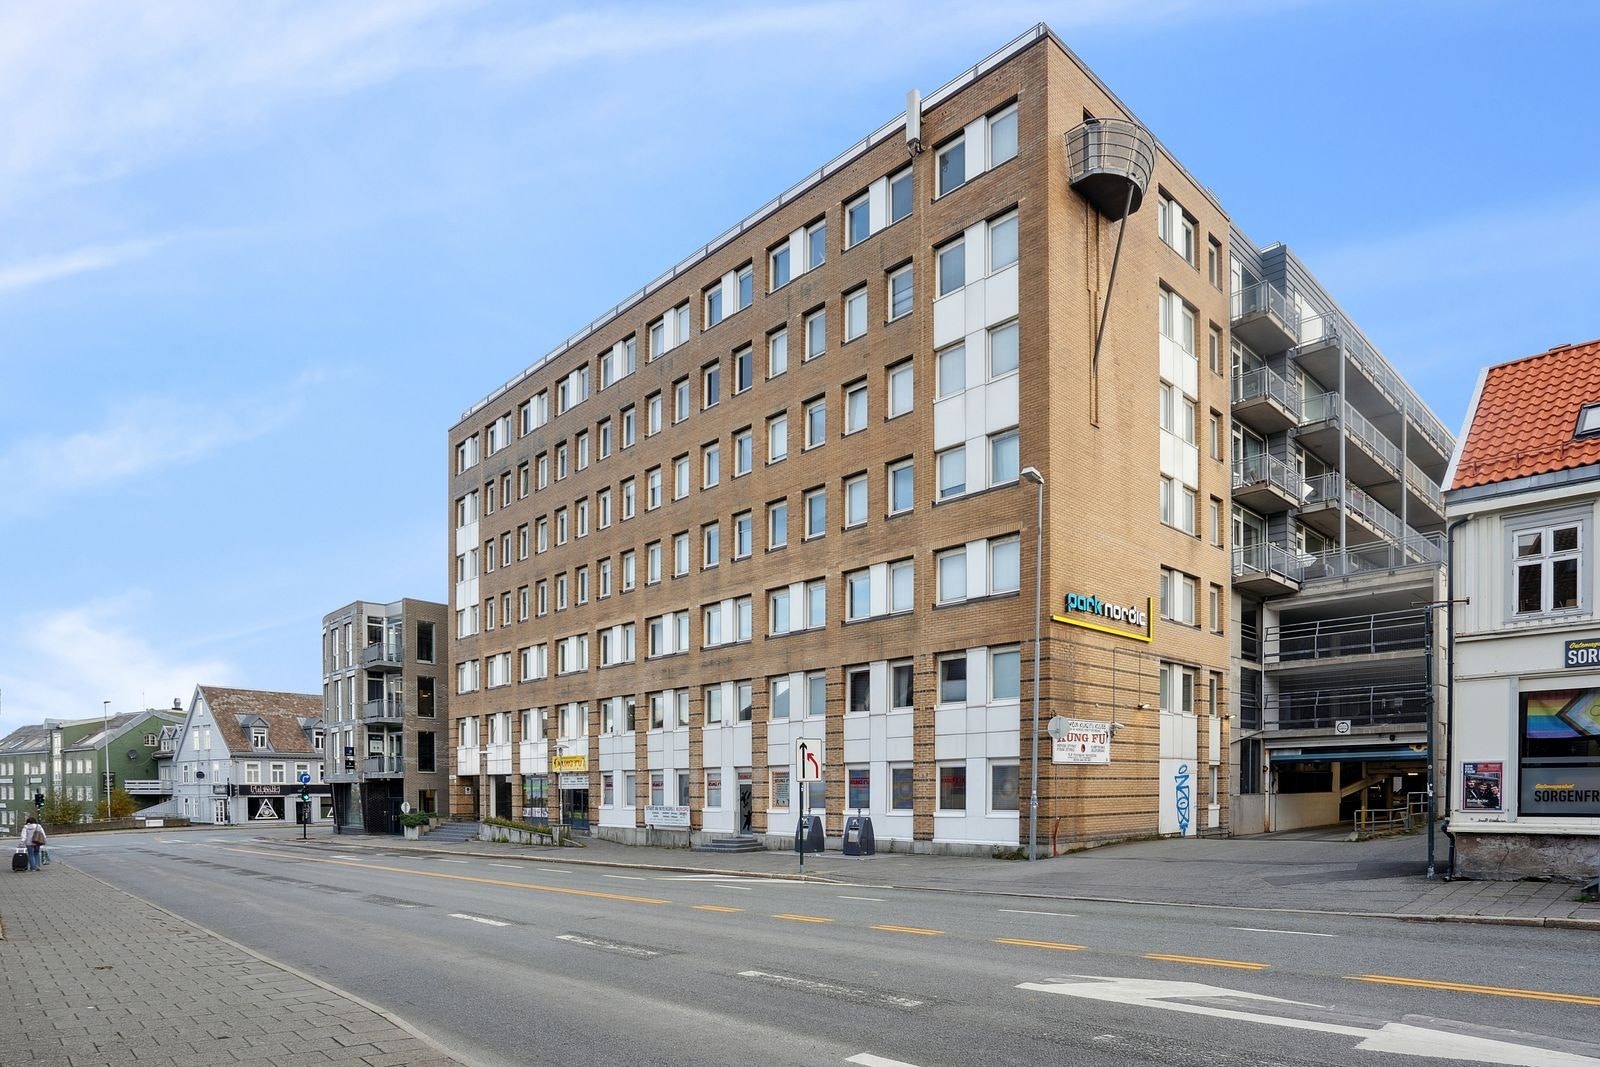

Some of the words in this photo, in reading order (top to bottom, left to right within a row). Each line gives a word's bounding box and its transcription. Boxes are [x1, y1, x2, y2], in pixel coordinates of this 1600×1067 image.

[1066, 592, 1103, 615] park
[1104, 603, 1146, 626] nordic
[1568, 649, 1600, 665] SOR
[1092, 733, 1106, 745] FU
[1534, 790, 1600, 802] SORGENFR
